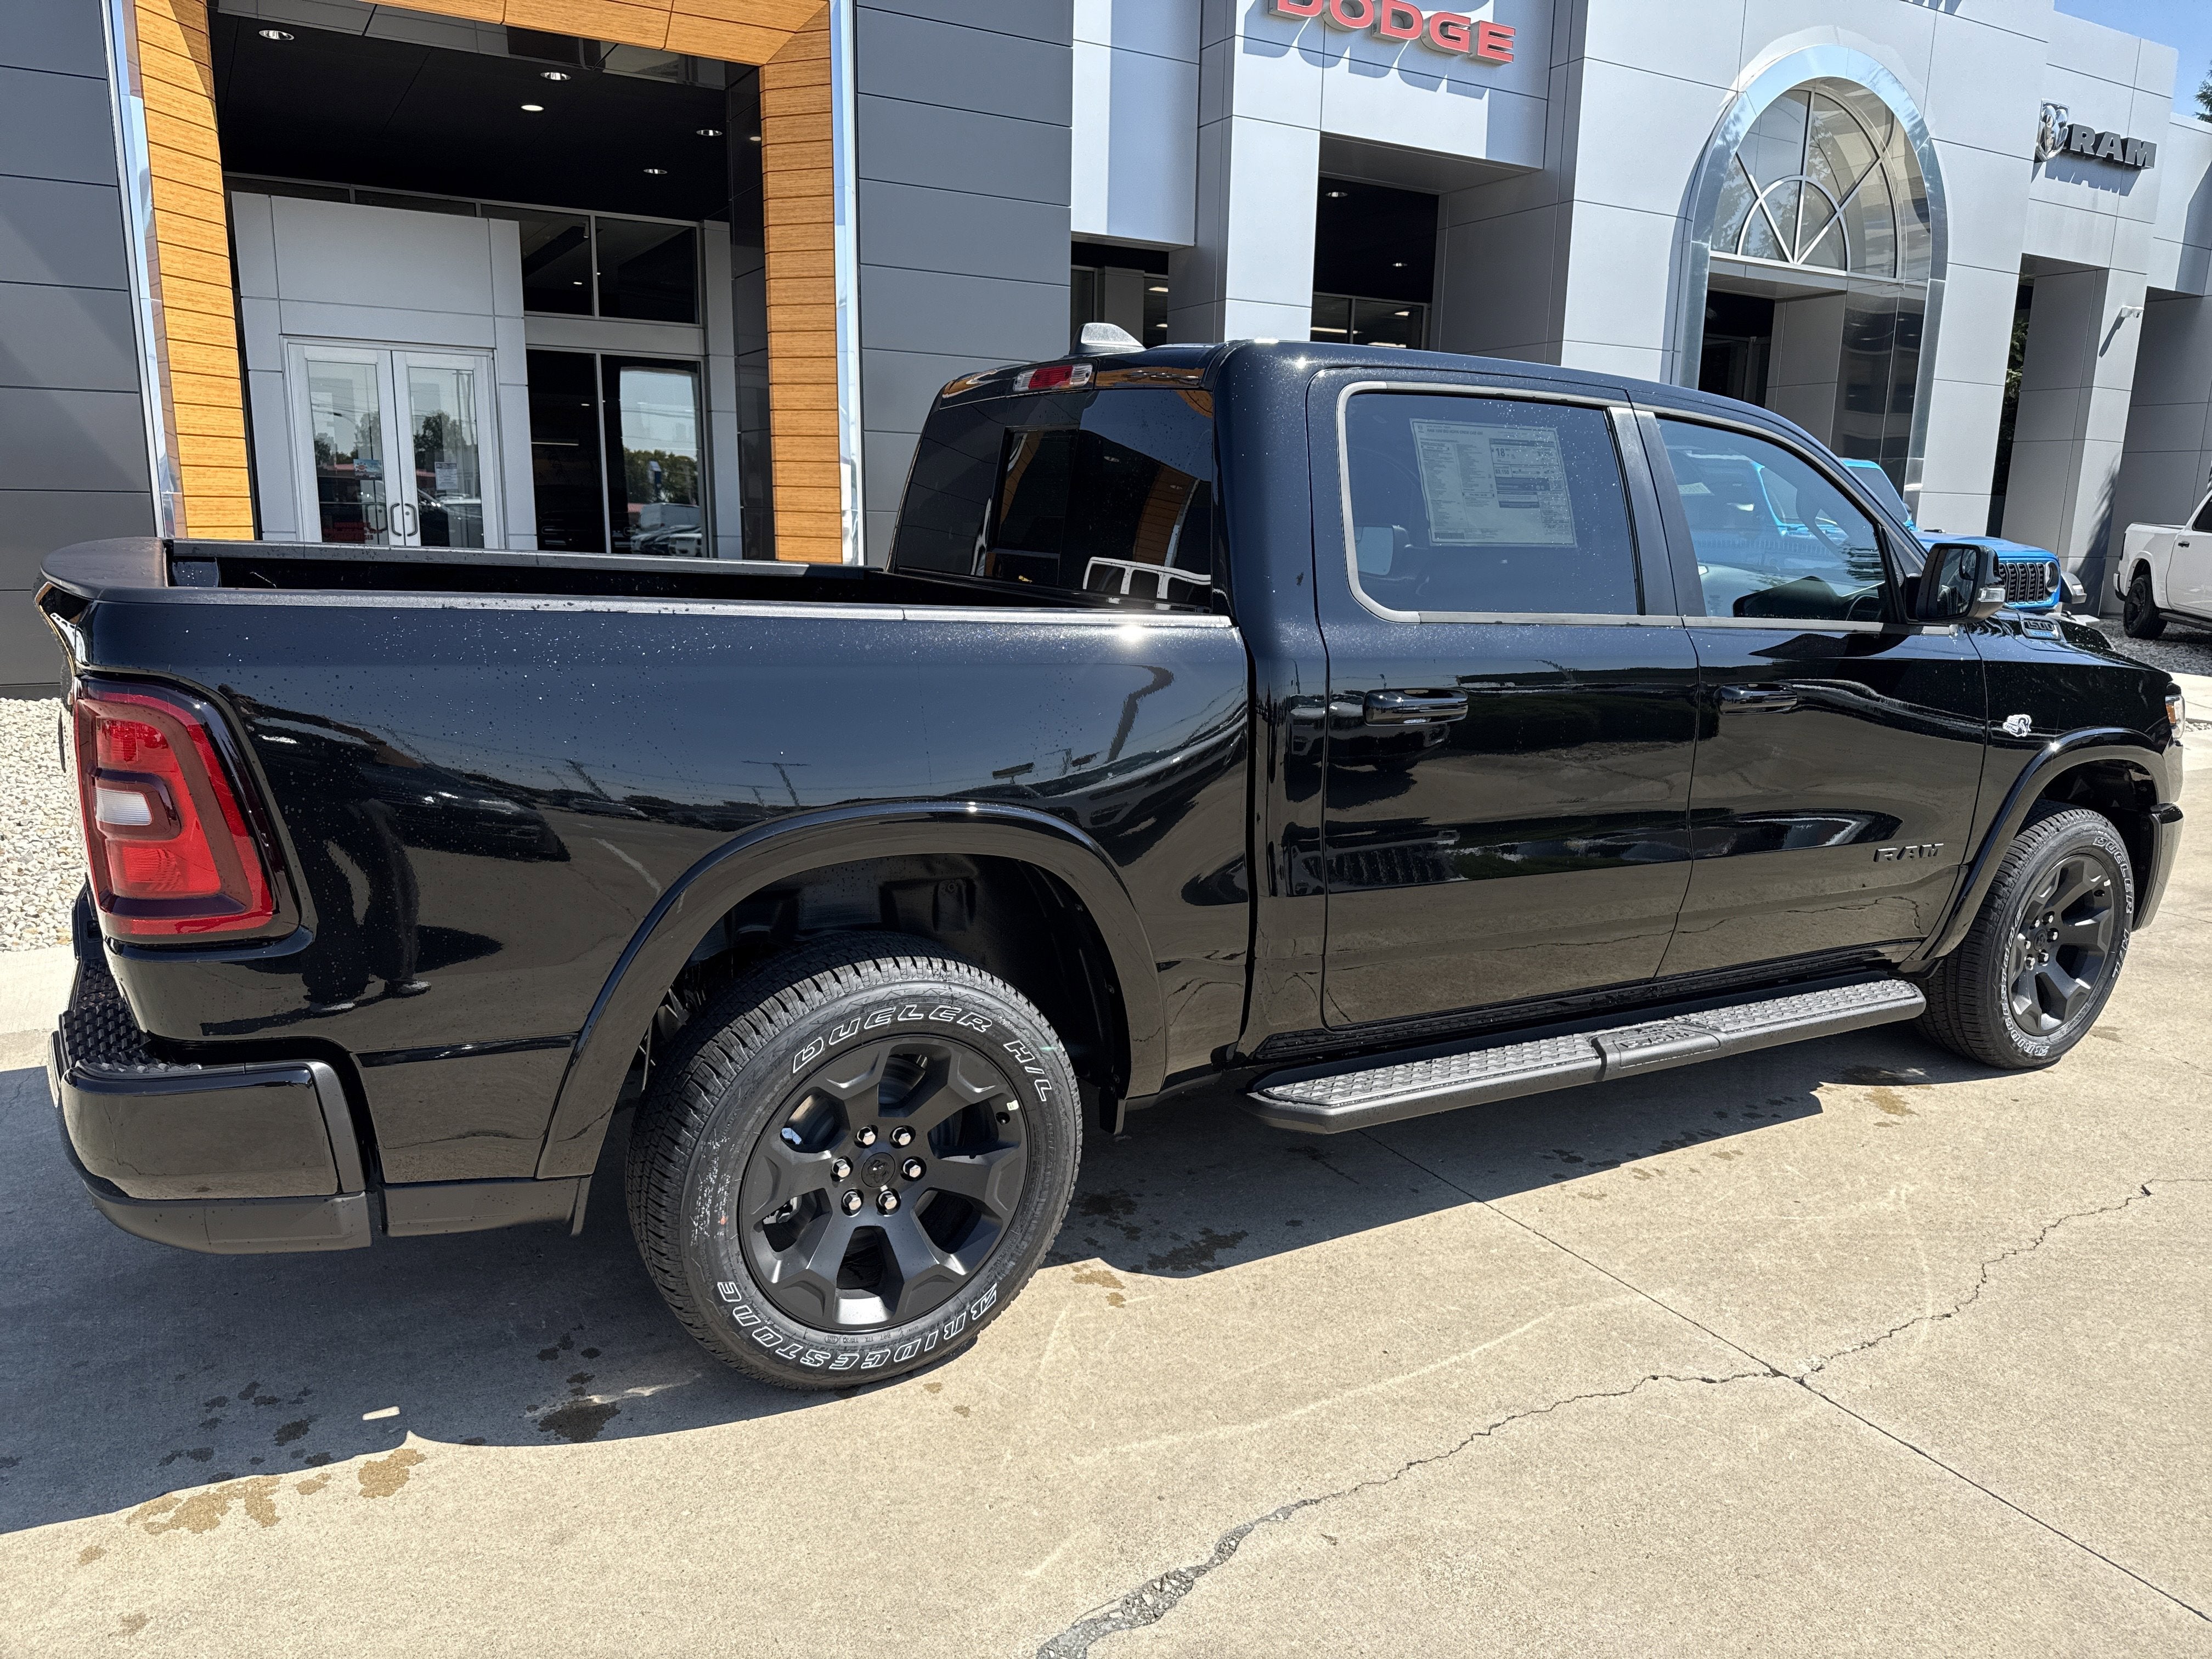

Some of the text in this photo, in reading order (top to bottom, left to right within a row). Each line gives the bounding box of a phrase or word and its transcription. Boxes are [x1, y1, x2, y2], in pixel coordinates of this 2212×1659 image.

[2068, 123, 2157, 168] RAM
[1496, 448, 1505, 456] 18
[2025, 620, 2055, 631] 1500
[1874, 843, 1944, 862] RAM
[2092, 836, 2134, 914] DUELER
[792, 1004, 993, 1074] DUELER
[716, 1281, 998, 1370] BRIDGESTONE
